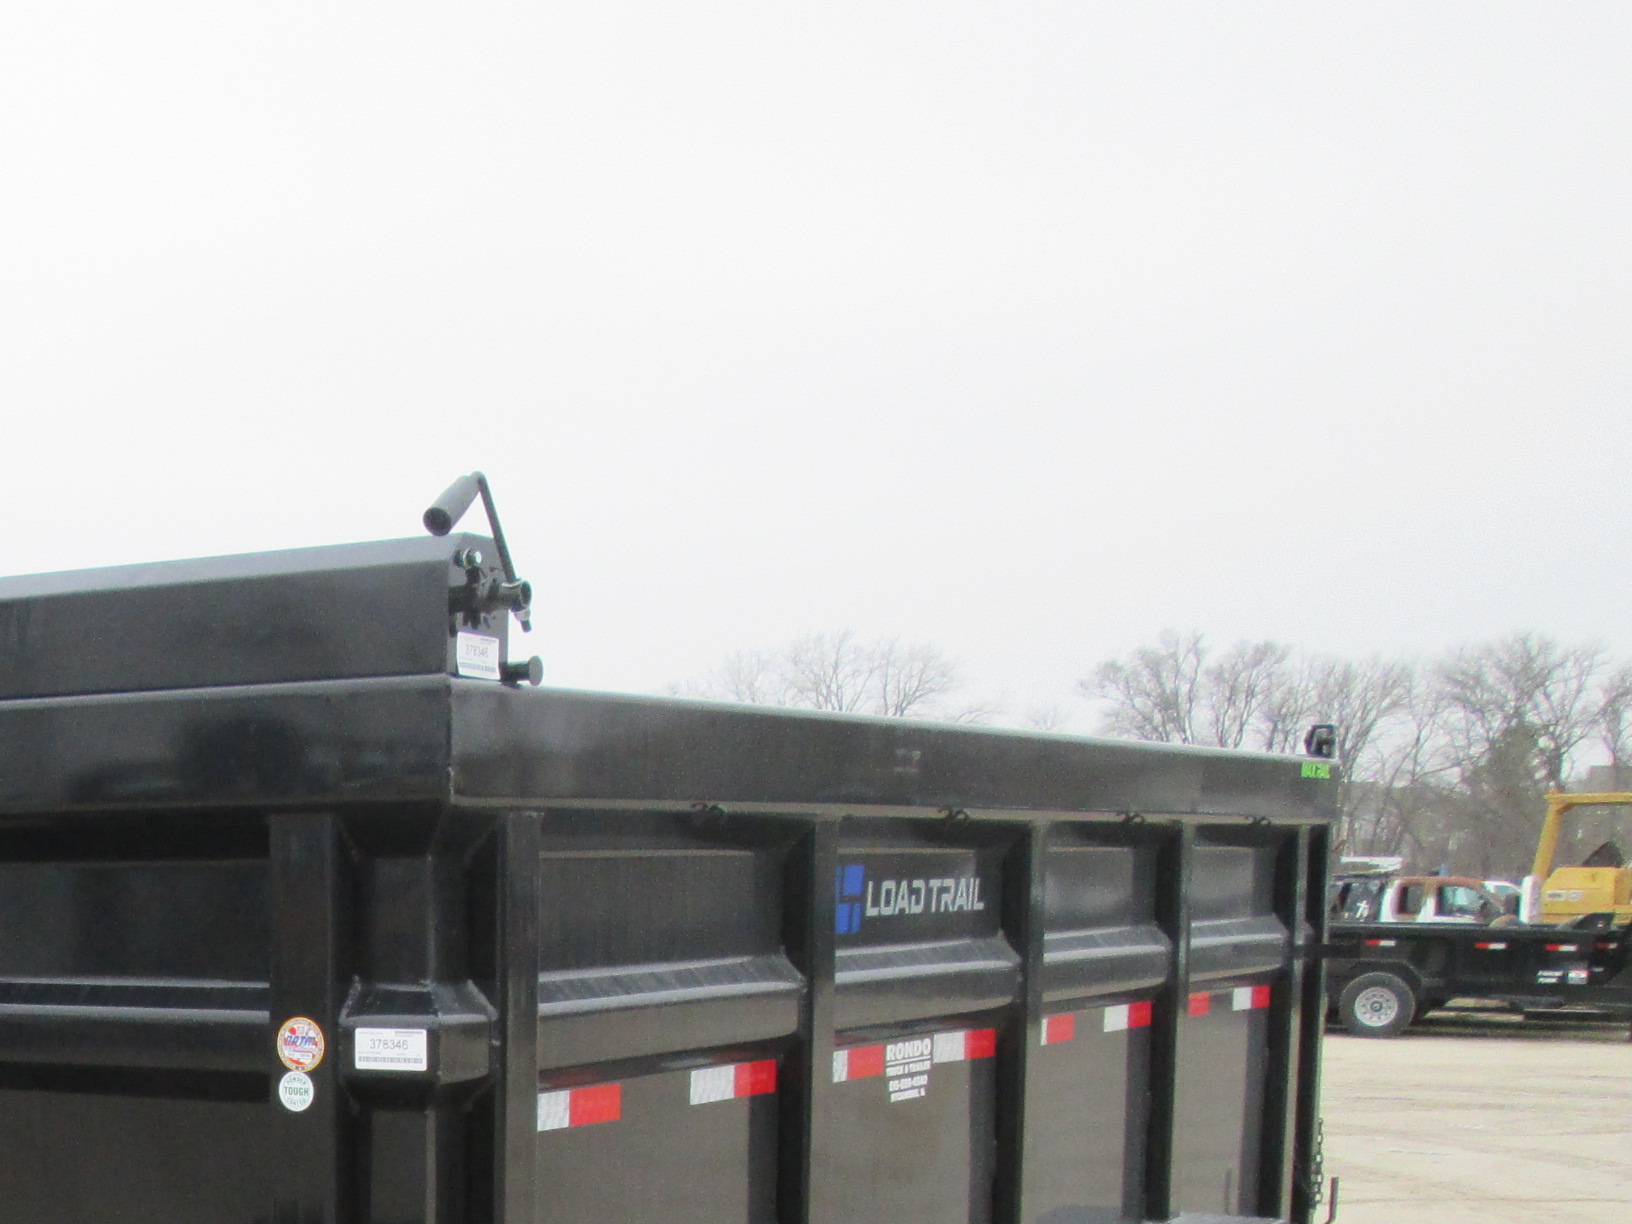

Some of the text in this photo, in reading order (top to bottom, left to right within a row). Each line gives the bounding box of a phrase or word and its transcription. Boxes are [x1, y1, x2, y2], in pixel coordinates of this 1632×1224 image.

[866, 877, 985, 917] LOAD TRAIL
[369, 1038, 409, 1050] 378346
[886, 1038, 931, 1061] RONDO
[284, 1087, 309, 1096] TOUGH
